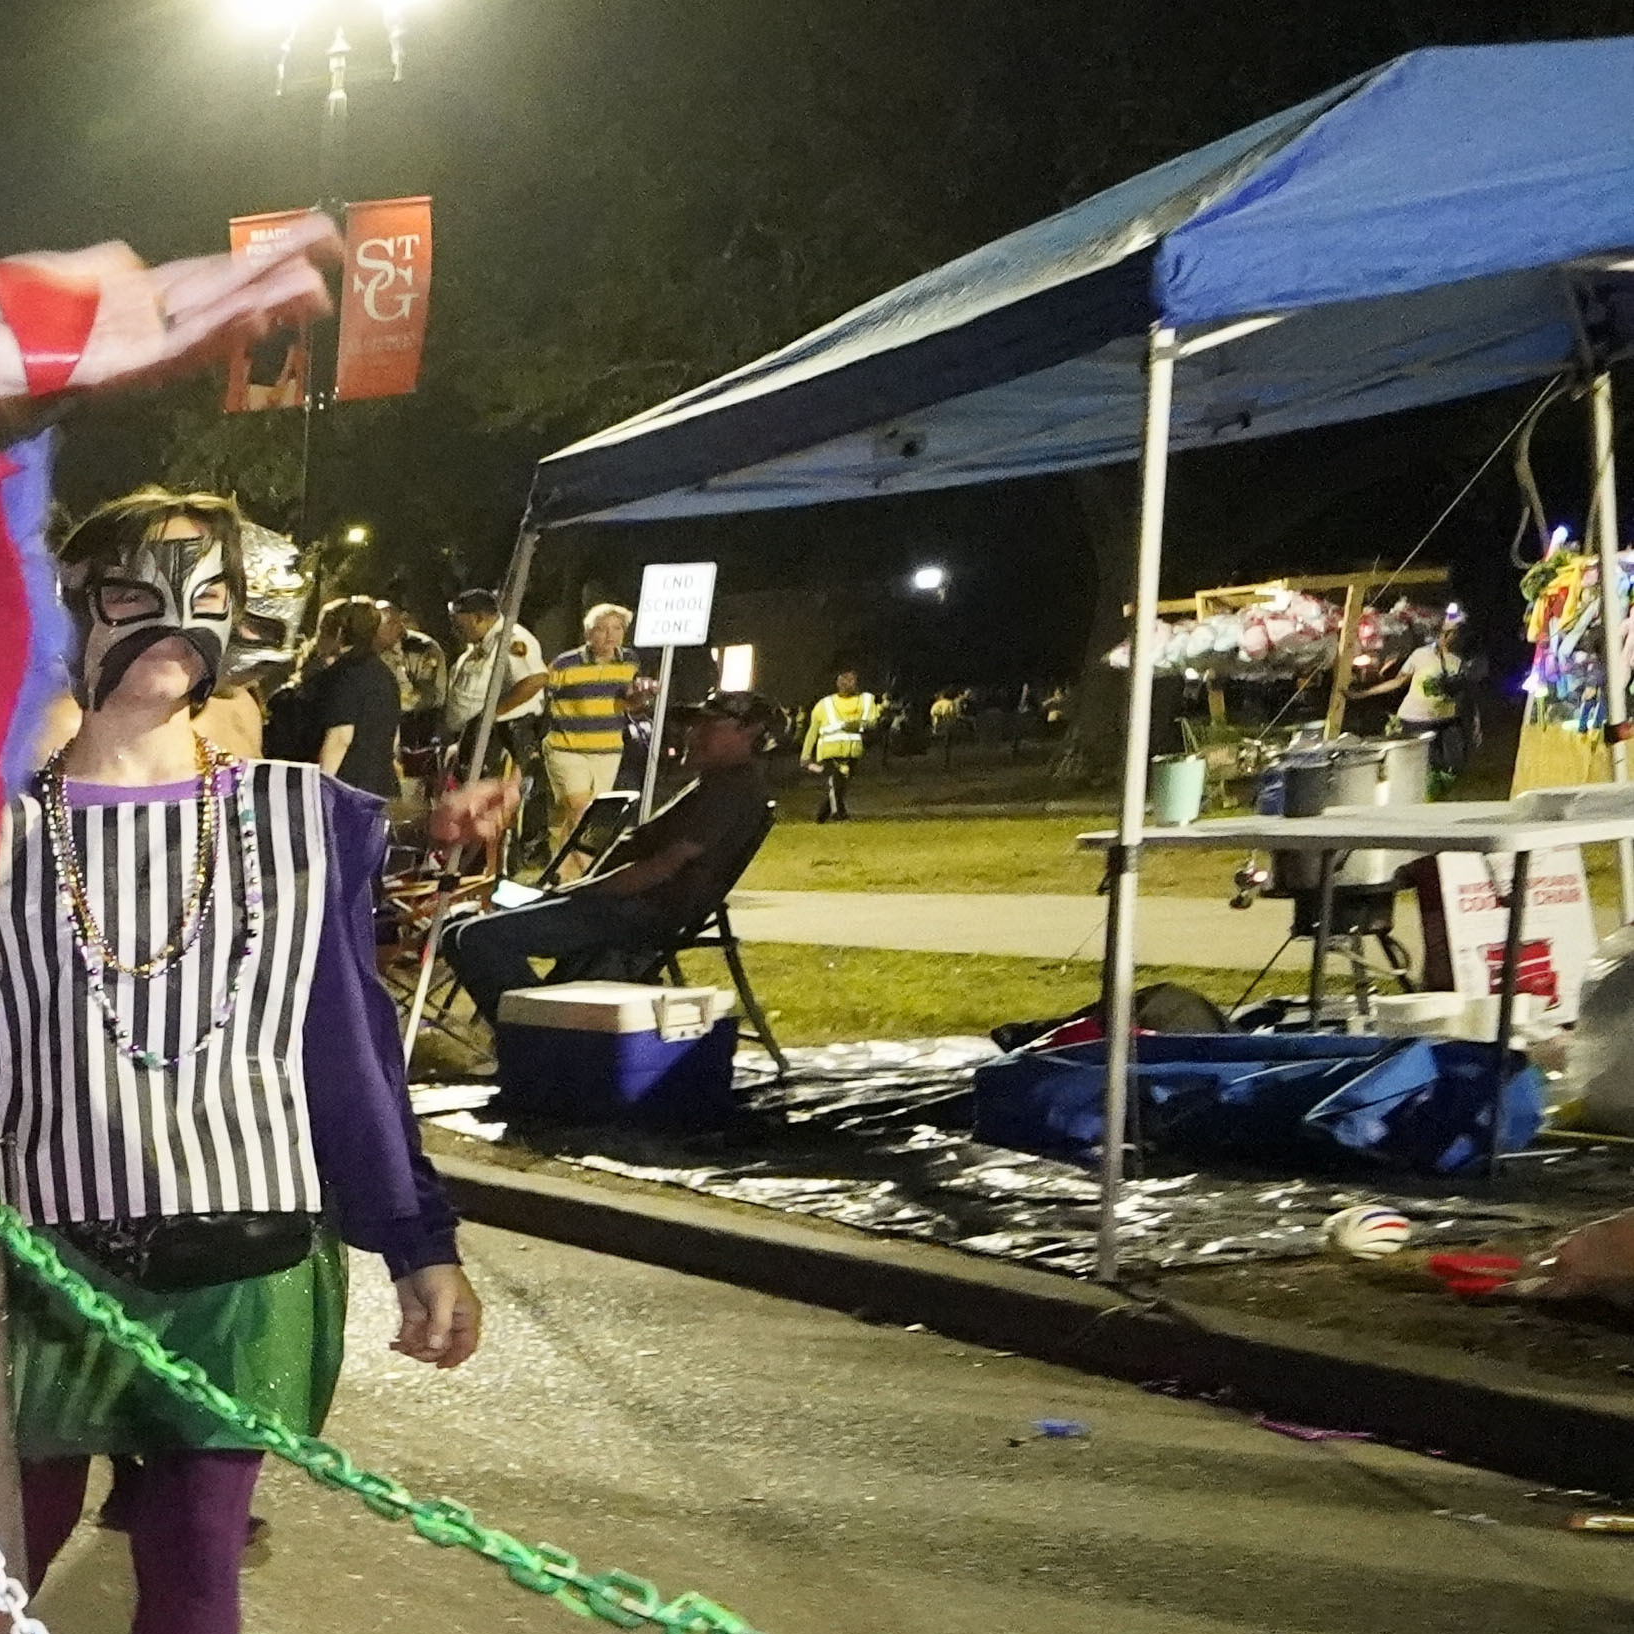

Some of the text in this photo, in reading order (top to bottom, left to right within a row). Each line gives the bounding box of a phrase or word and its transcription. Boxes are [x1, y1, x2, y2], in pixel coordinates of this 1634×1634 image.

[662, 575, 694, 589] END
[643, 596, 705, 613] SCHOOL
[651, 619, 693, 635] ZONE
